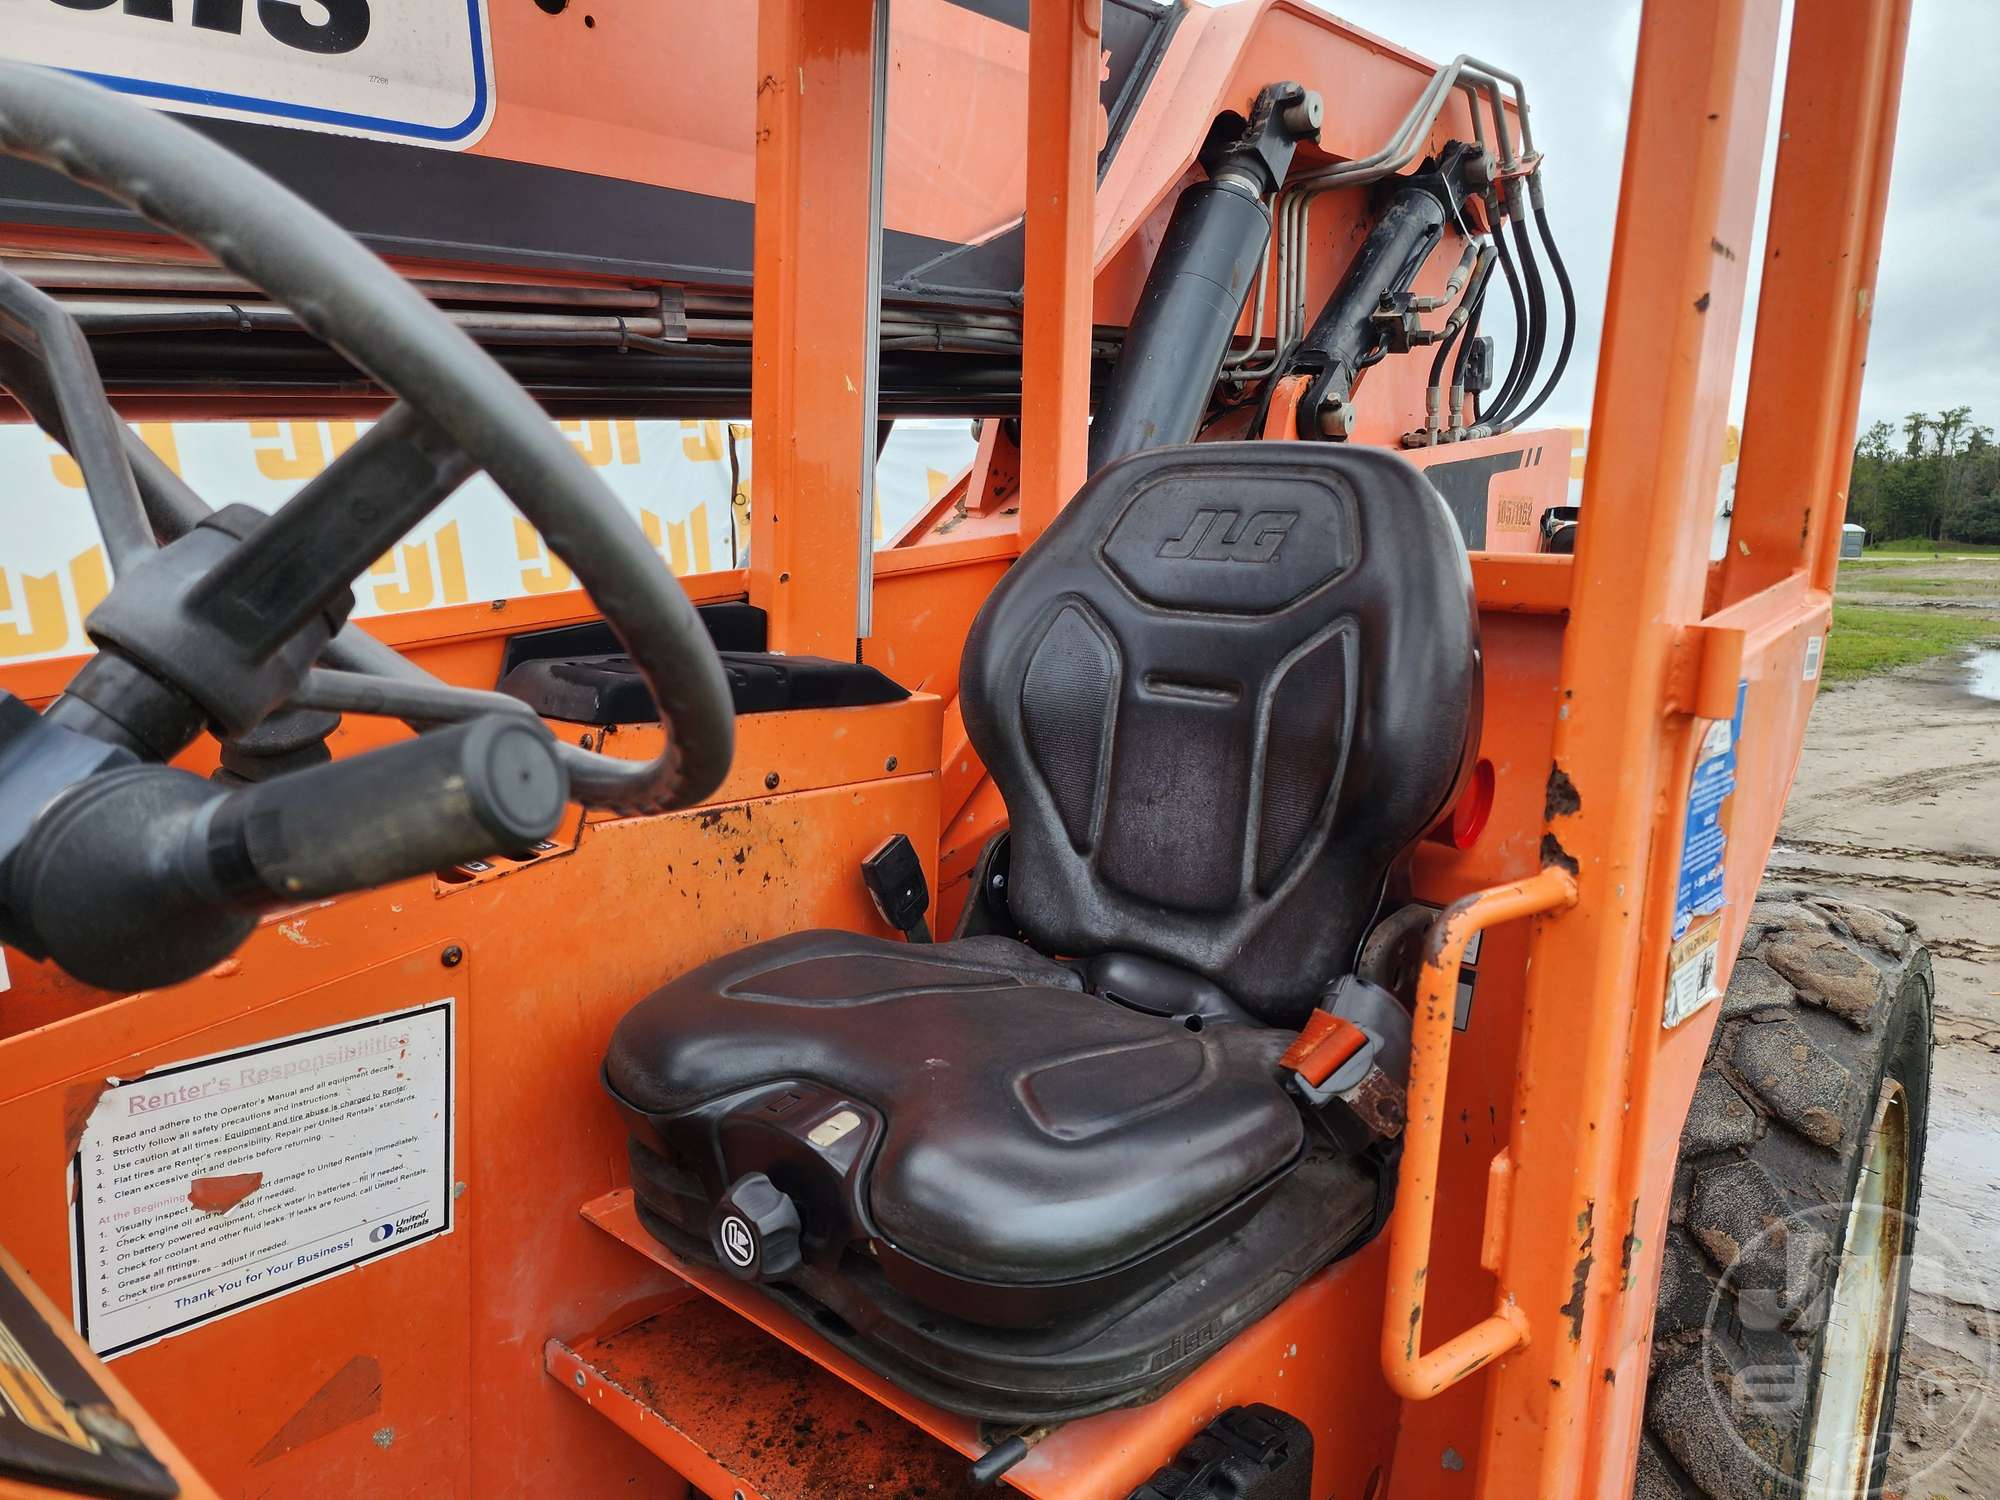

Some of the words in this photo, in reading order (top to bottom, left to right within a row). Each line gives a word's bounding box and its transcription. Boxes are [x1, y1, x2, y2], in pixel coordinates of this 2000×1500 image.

[1156, 508, 1299, 563] JLG
[112, 1131, 136, 1144] Read
[139, 1125, 157, 1136] and
[159, 1118, 190, 1131] adhere
[204, 1111, 218, 1119] the
[220, 1098, 265, 1115] Operator's
[267, 1089, 297, 1102] Manual
[299, 1084, 314, 1094] and
[328, 1070, 368, 1086] equipment
[128, 1077, 230, 1114] Renter's
[112, 1143, 146, 1157] Strictly
[149, 1135, 177, 1148] follow
[192, 1124, 219, 1136] safety
[221, 1110, 271, 1130] precautions
[273, 1104, 289, 1114] and
[113, 1162, 131, 1171] Use
[134, 1151, 168, 1165] caution
[225, 1122, 271, 1141] Equipment
[272, 1117, 288, 1128] and
[305, 1107, 329, 1119] abuse
[340, 1094, 371, 1109] charged
[114, 1175, 132, 1185] Flat
[134, 1169, 154, 1180] tires
[157, 1164, 172, 1173] are
[174, 1153, 211, 1168] Renter's
[275, 1127, 302, 1139] Repair
[318, 1114, 344, 1126] United
[114, 1187, 141, 1199] Clean
[144, 1173, 189, 1190] excessive
[191, 1167, 206, 1177] dirt
[208, 1161, 225, 1172] and
[227, 1154, 254, 1166] debris
[256, 1146, 282, 1158] before
[116, 1218, 153, 1233] Visually
[155, 1206, 188, 1222] inspect
[273, 1171, 305, 1185] damage
[317, 1158, 343, 1171] United
[345, 1150, 373, 1163] Rentals
[113, 1211, 130, 1221] the
[133, 1195, 185, 1215] Beginning
[116, 1233, 146, 1248] Check
[148, 1224, 179, 1238] engine
[195, 1213, 211, 1223] and
[117, 1261, 146, 1275] Check
[164, 1244, 198, 1259] coolant
[200, 1237, 216, 1248] and
[218, 1230, 241, 1242] other
[243, 1222, 262, 1234] fluid
[296, 1205, 317, 1216] leaks
[374, 1177, 398, 1189] United
[133, 1241, 165, 1256] battery
[168, 1227, 206, 1247] powered
[257, 1203, 282, 1216] check
[284, 1196, 306, 1207] water
[317, 1182, 350, 1197] batteries
[395, 1218, 429, 1235] Rentals
[396, 1210, 427, 1227] United
[118, 1274, 151, 1289] Grease
[166, 1258, 200, 1273] fittings.
[118, 1288, 147, 1303] Check
[150, 1283, 165, 1292] tire
[167, 1267, 211, 1287] pressures
[221, 1253, 247, 1267] adjust
[174, 1288, 215, 1309] Thank
[218, 1280, 242, 1293] You
[245, 1272, 262, 1284] for
[266, 1261, 294, 1276] Your
[297, 1237, 353, 1266] Business!
